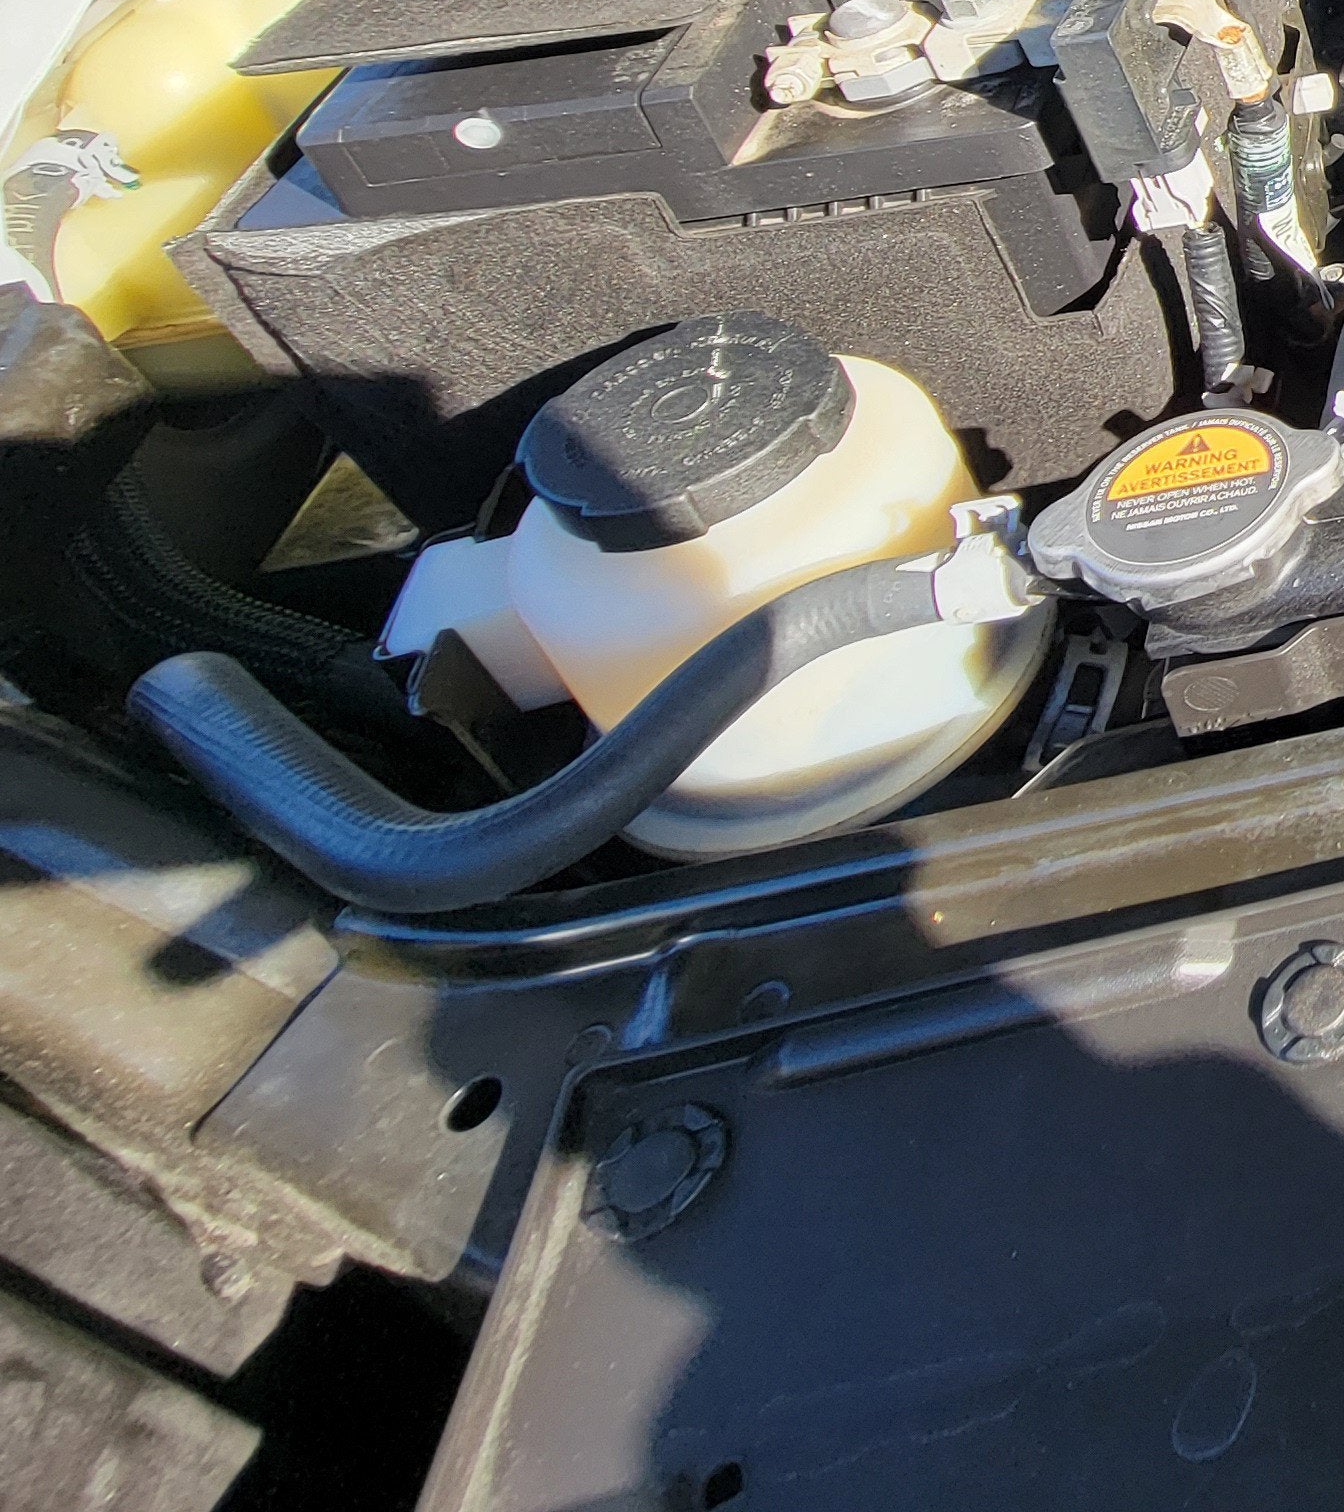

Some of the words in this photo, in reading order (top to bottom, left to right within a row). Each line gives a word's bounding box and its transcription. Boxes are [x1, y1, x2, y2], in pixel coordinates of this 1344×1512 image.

[1117, 458, 1260, 495] AVERTISSEMENT
[1145, 449, 1237, 476] WARNING
[1111, 508, 1128, 521] NE
[1127, 502, 1166, 519] JAMAIS
[1166, 495, 1207, 510] OUVRIR
[1217, 486, 1259, 500] CHAUD.
[1117, 494, 1155, 509] NEVER
[1156, 487, 1190, 502] OPEN
[1192, 481, 1228, 496] WHEN
[1230, 476, 1256, 490] HOT.
[1126, 518, 1163, 531] NISSAN
